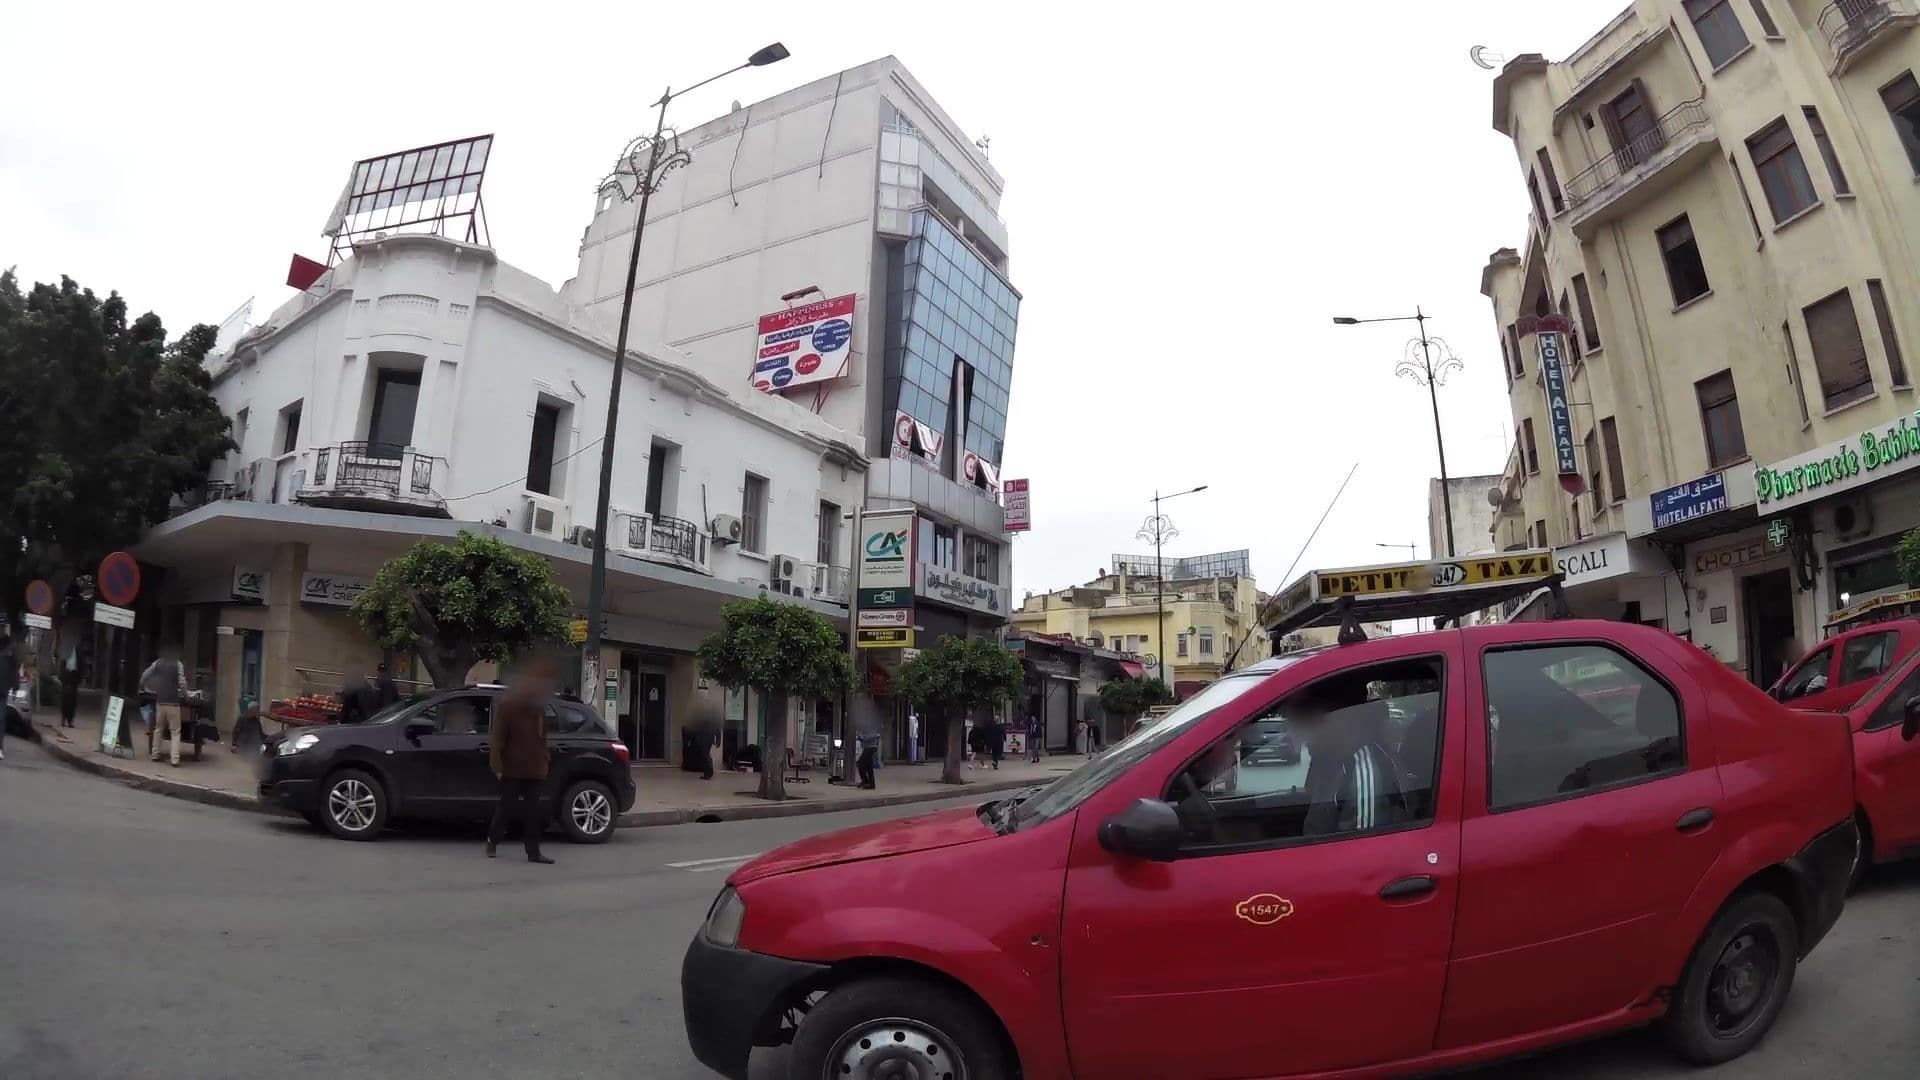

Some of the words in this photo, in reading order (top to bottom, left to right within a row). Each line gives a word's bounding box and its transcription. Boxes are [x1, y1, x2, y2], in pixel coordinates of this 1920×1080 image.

[1540, 335, 1561, 390] HOTEL
[1755, 445, 1859, 503] Pharmacie
[1656, 508, 1687, 527] HOTEL
[1477, 556, 1549, 579] TAXI
[1558, 549, 1609, 576] SCALI
[1251, 904, 1279, 915] 1547
